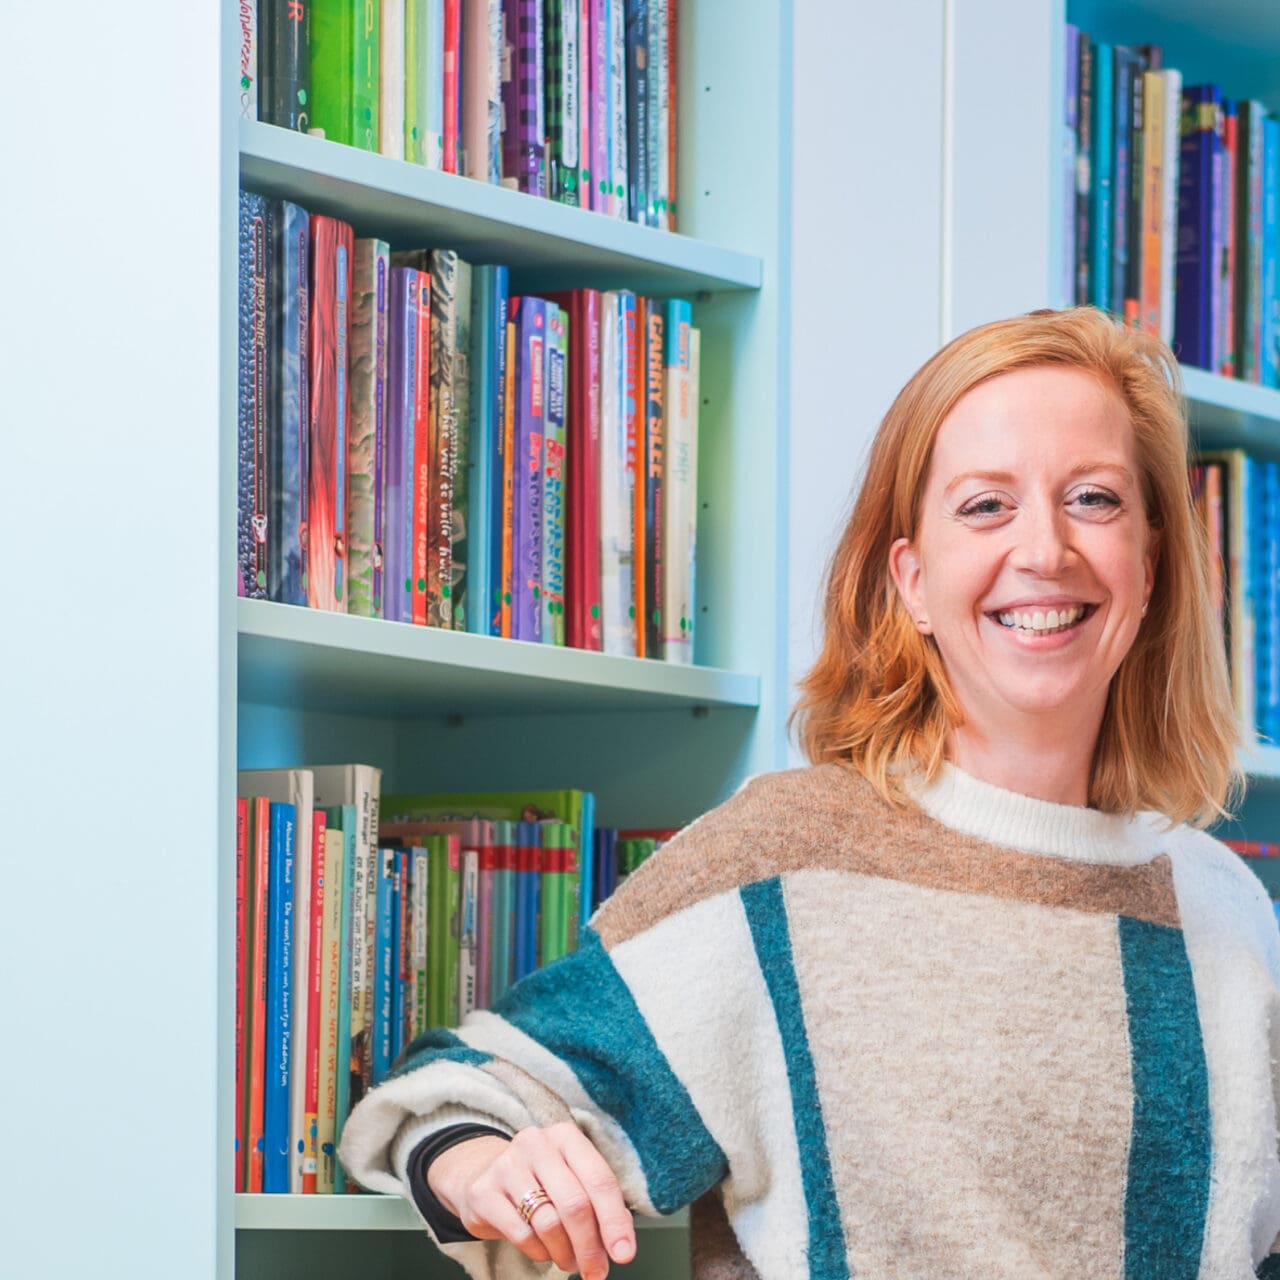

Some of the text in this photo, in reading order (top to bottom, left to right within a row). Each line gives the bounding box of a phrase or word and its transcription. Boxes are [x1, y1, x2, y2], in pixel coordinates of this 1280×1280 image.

[255, 276, 267, 307] Harry
[256, 309, 266, 349] Potter
[649, 314, 664, 479] CARRY SLEE
[440, 503, 452, 536] volle
[285, 821, 293, 856] Michael
[366, 797, 379, 896] Paul Biegel
[284, 858, 293, 884] Bond
[317, 825, 326, 907] BOLLEBOOS
[284, 902, 292, 916] De
[282, 918, 291, 969] avonturen
[279, 991, 290, 1027] beertje
[279, 1031, 290, 1088] Paddington
